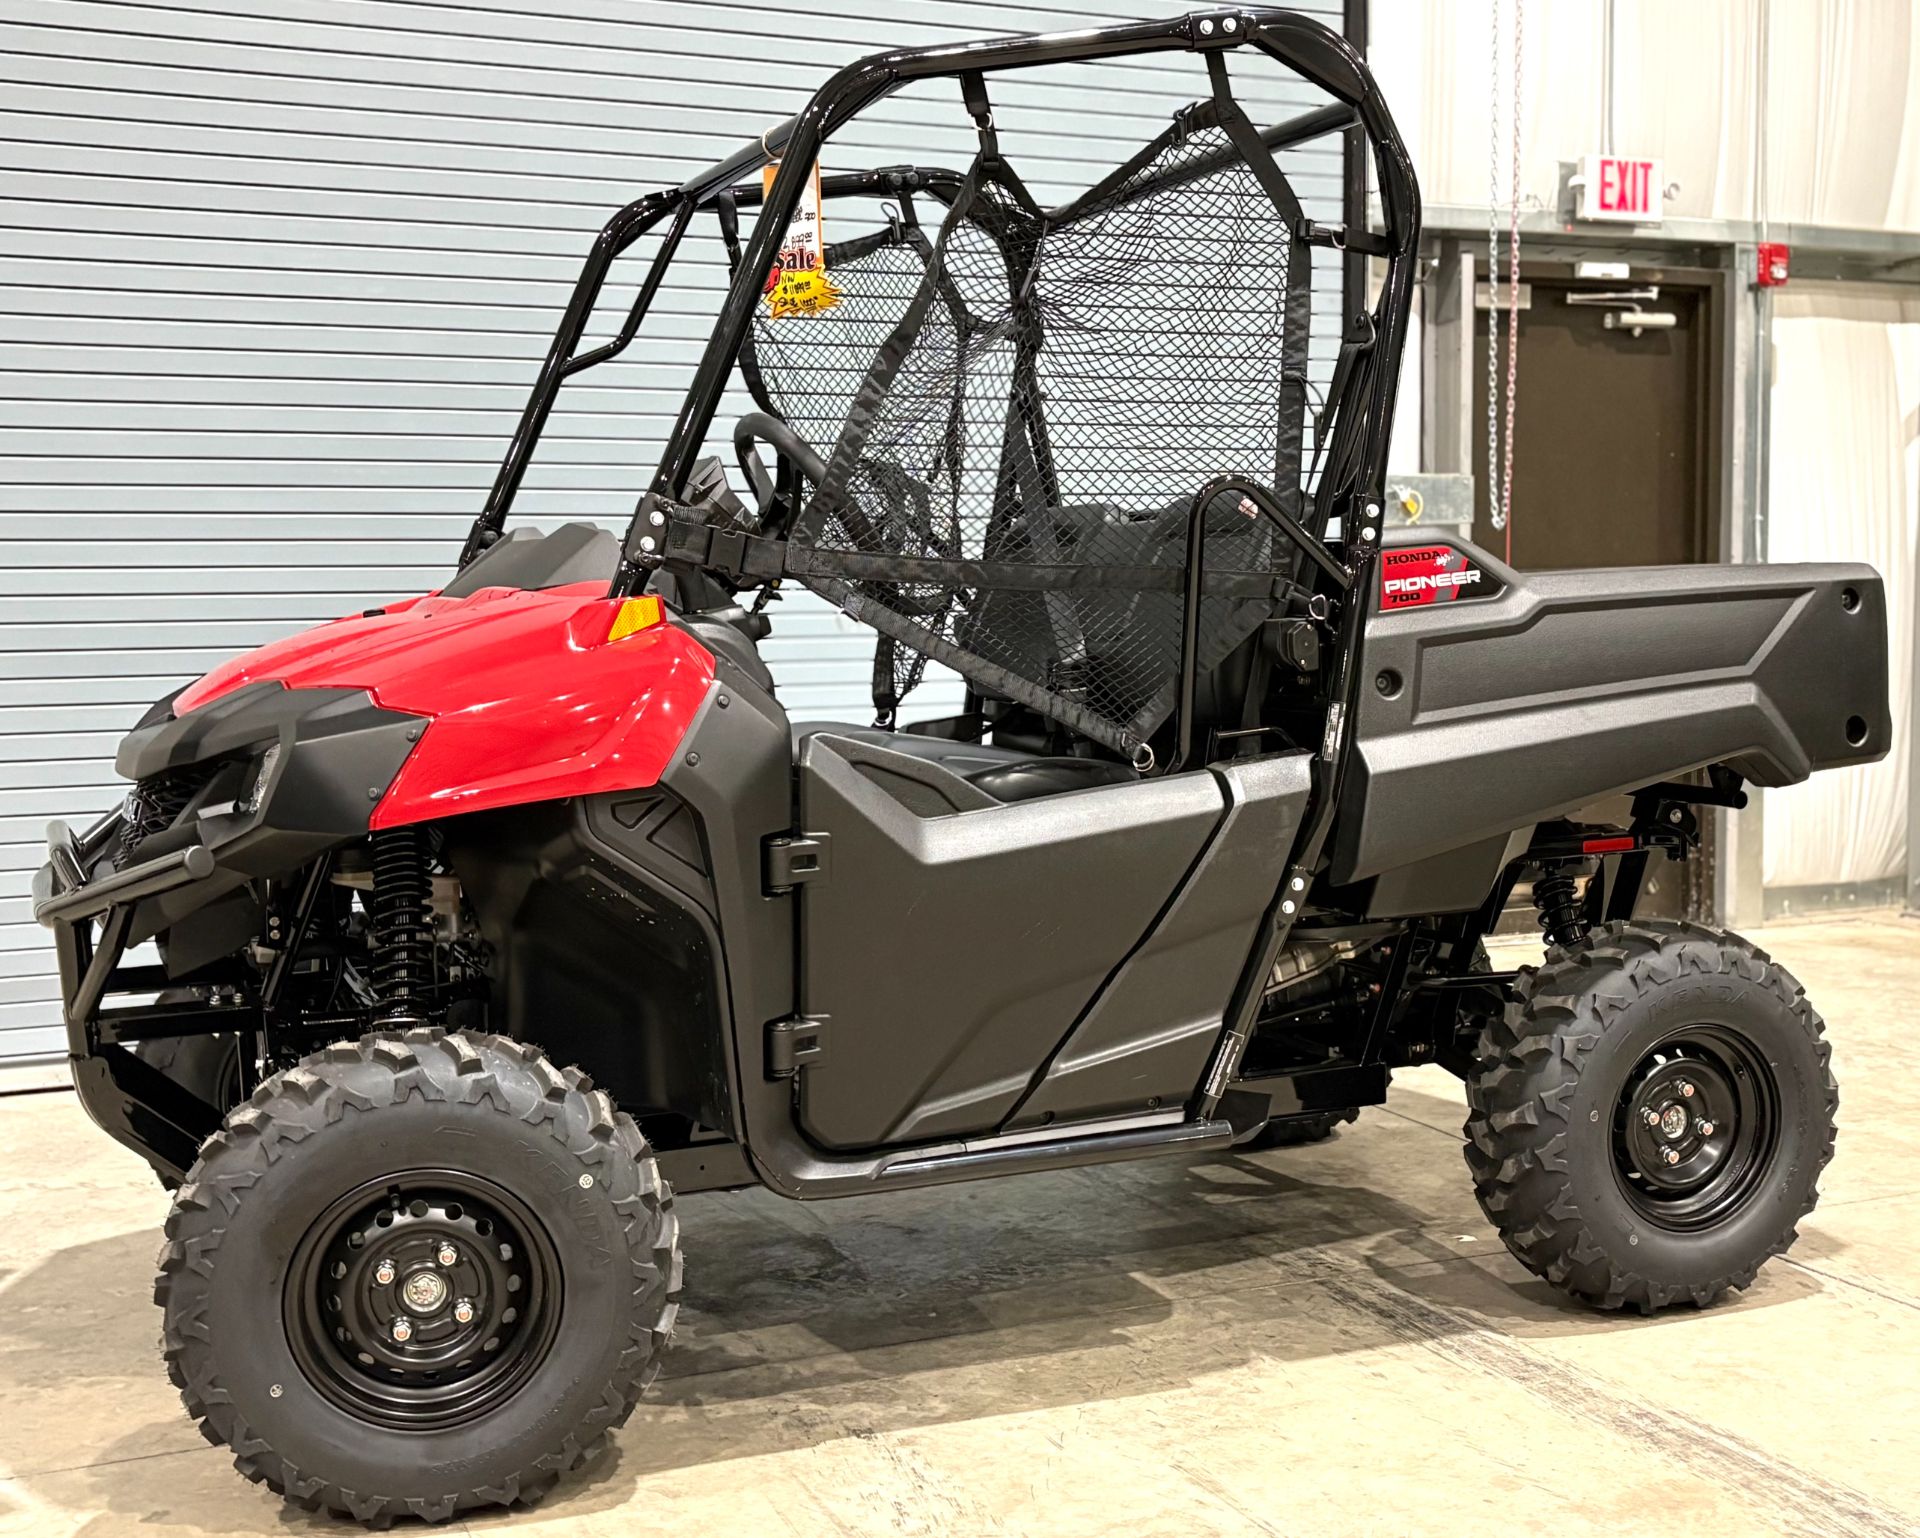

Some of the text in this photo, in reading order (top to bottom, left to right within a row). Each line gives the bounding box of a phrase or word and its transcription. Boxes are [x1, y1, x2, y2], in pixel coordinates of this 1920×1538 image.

[1600, 159, 1653, 213] EXIT
[1386, 550, 1441, 566] HONDA
[1384, 569, 1481, 594] PIONEER
[1389, 592, 1420, 603] 700
[1648, 986, 1749, 1023] KENDA
